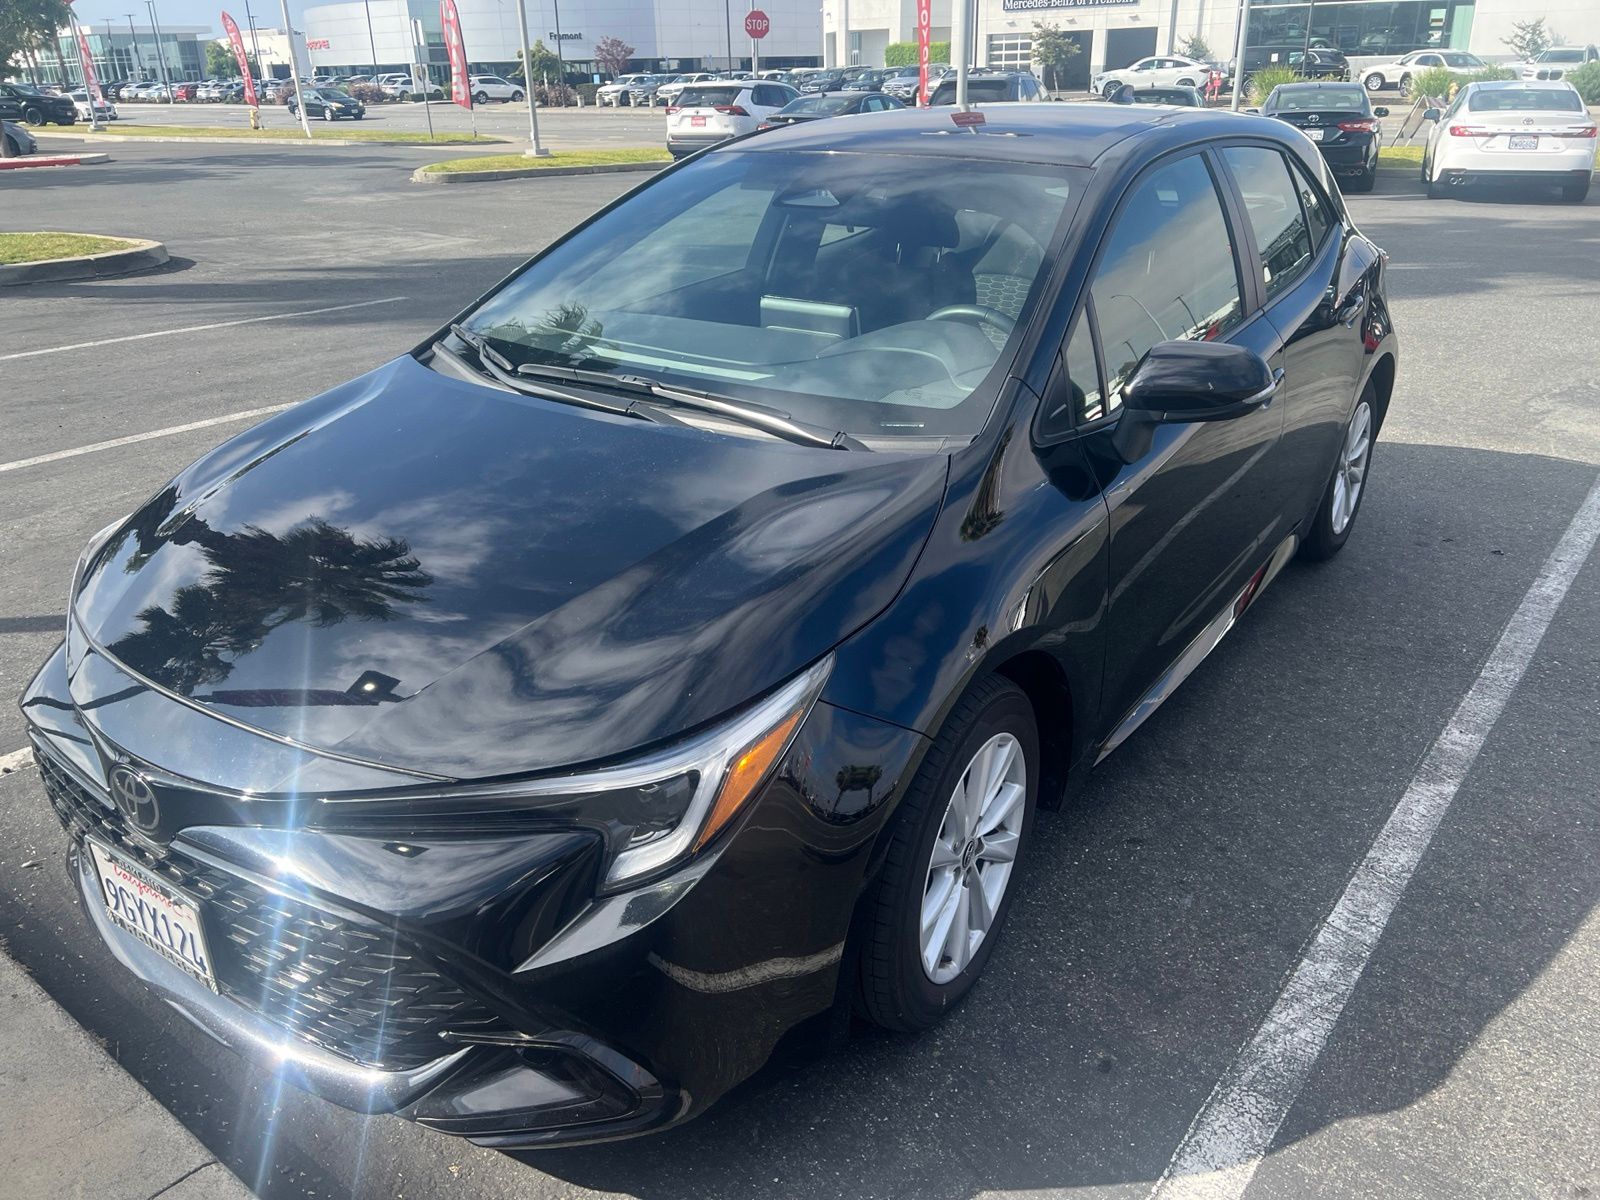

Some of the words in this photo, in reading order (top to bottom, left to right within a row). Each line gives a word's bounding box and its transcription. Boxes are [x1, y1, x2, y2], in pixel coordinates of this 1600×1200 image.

[549, 32, 583, 40] Fremont
[746, 19, 769, 31] STOP
[229, 31, 252, 97] TOYOTA
[105, 877, 208, 974] 9GYX124
